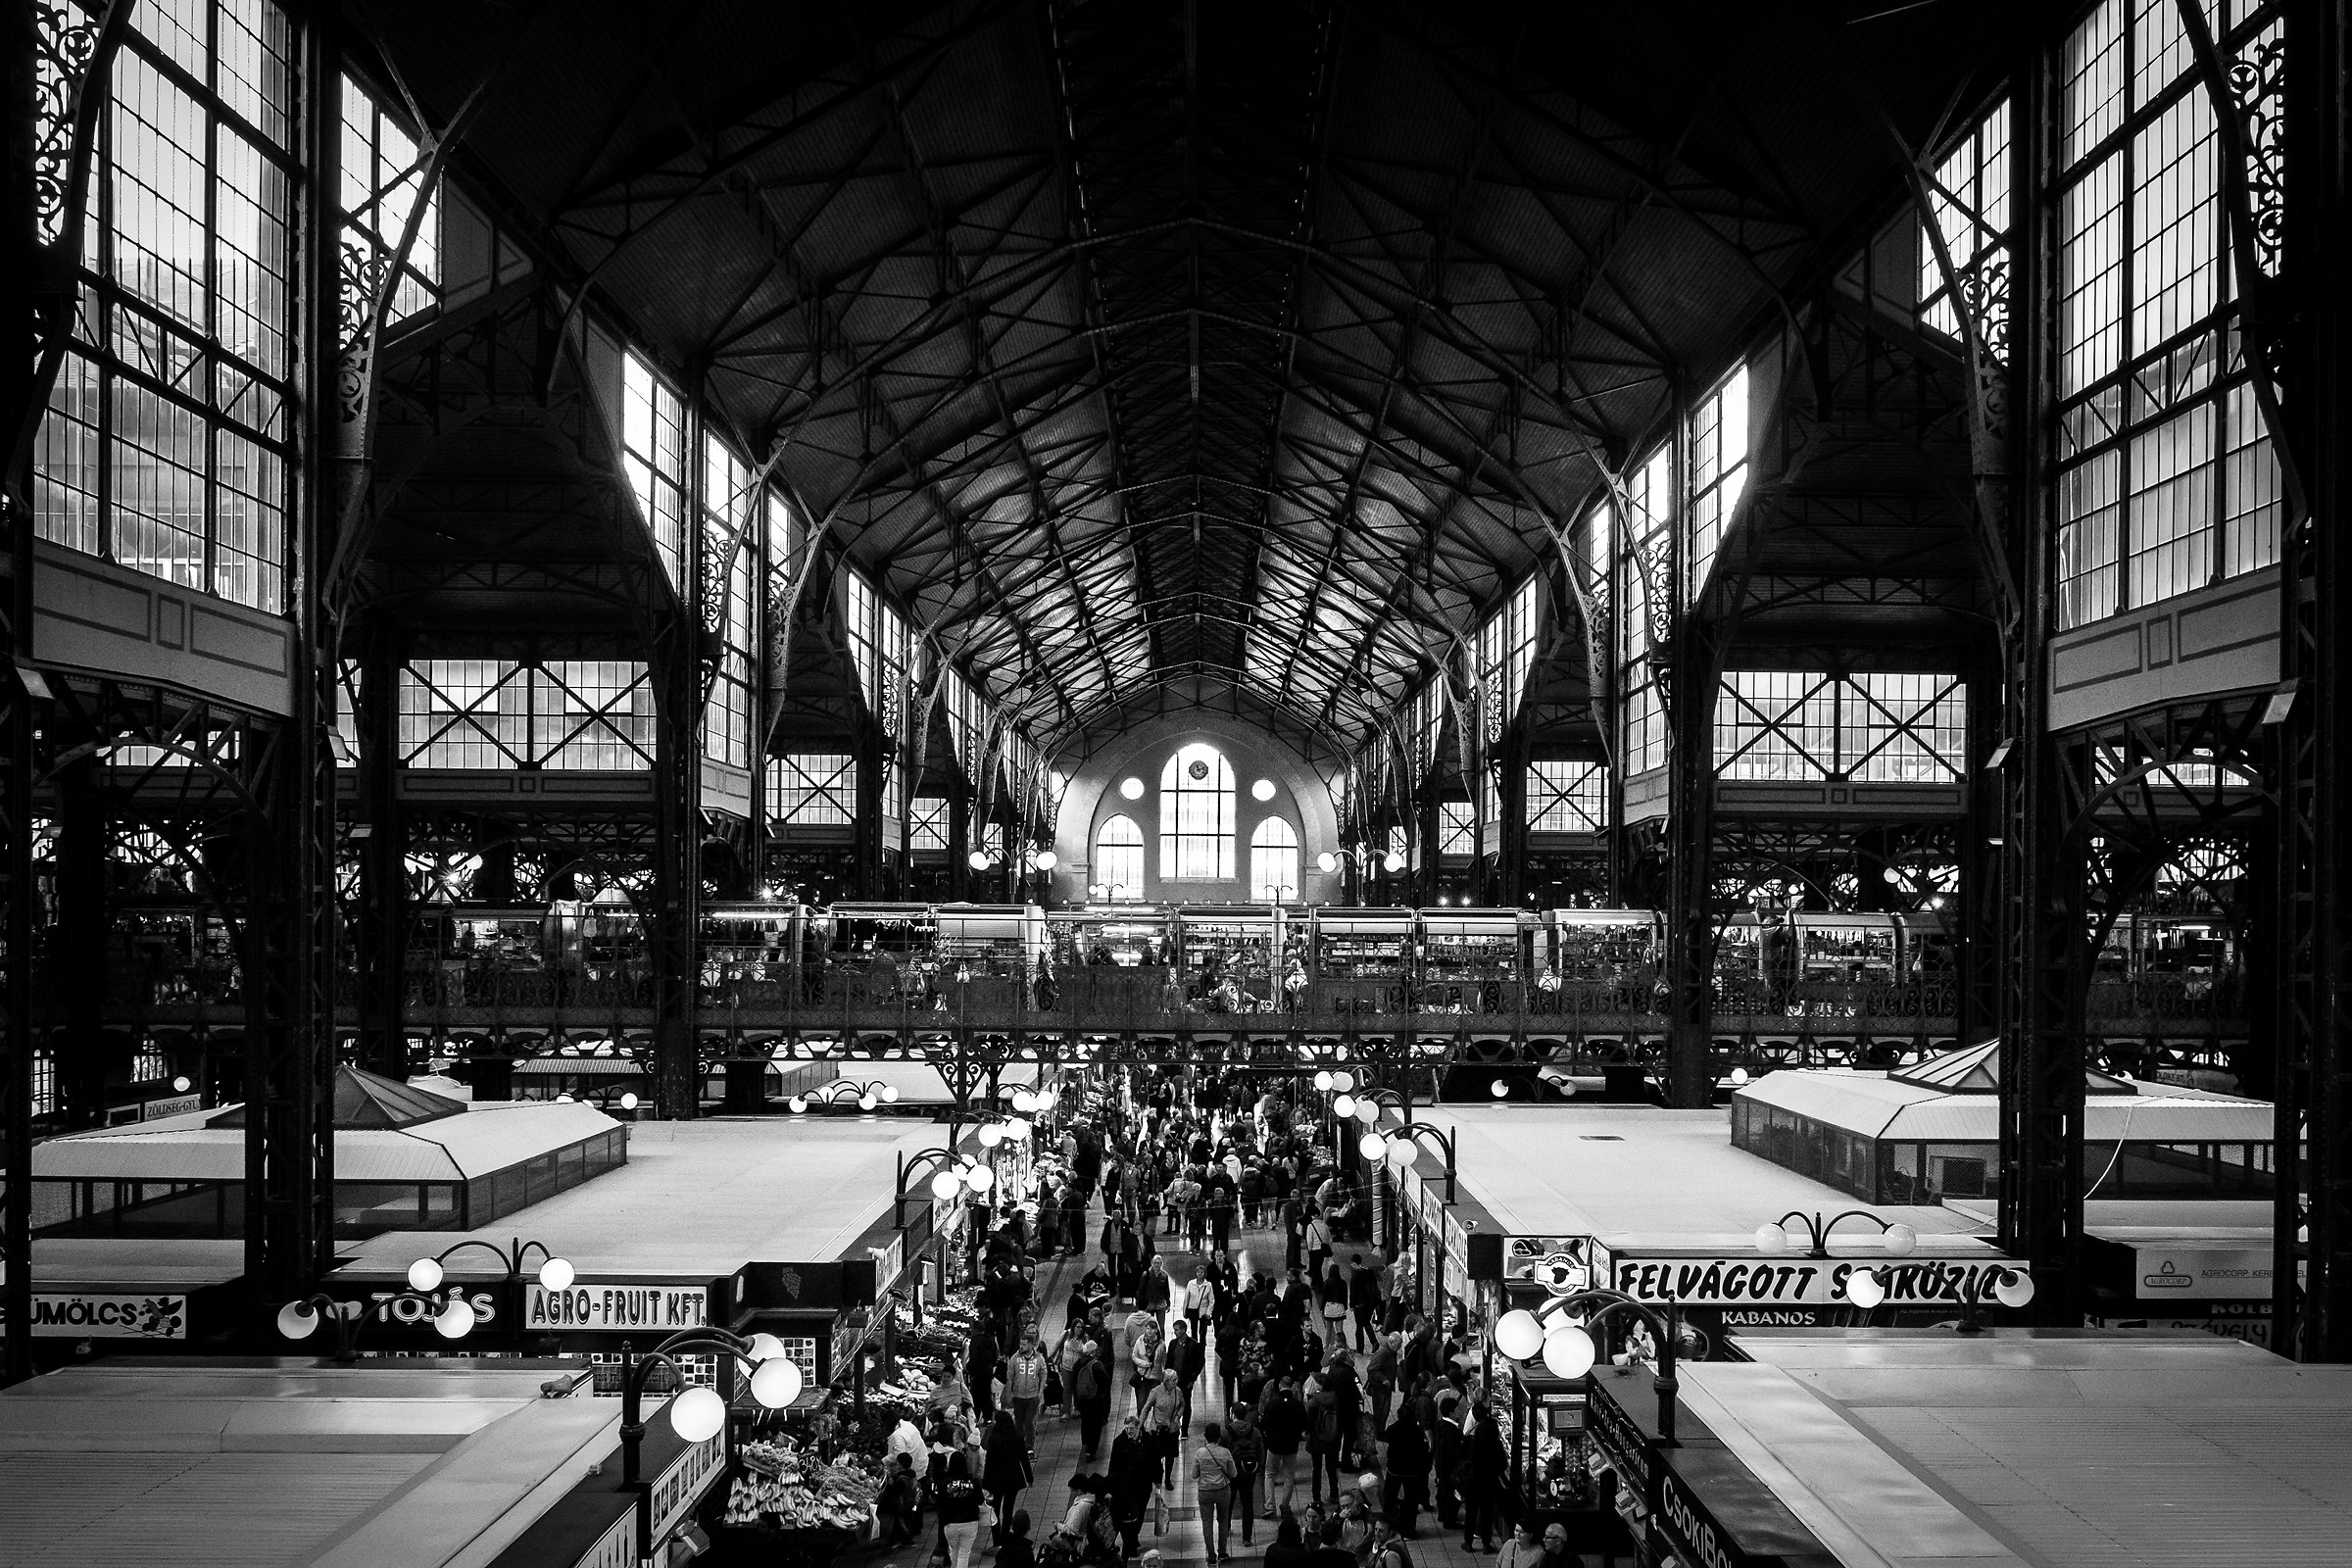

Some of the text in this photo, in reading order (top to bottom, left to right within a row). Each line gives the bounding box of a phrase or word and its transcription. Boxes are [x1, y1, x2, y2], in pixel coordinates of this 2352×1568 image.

[1619, 1260, 1818, 1300] FELVÁGOTT
[2202, 1269, 2248, 1278] AGROCORP
[0, 1298, 137, 1325] ÜMÖLCS
[531, 1289, 707, 1326] AGRO-FRUIT KFT.
[1722, 1310, 1816, 1325] KABANOS
[2211, 1303, 2274, 1314] KOLB
[1019, 1363, 1034, 1374] 92
[1663, 1476, 1732, 1568] CSOKIBO
